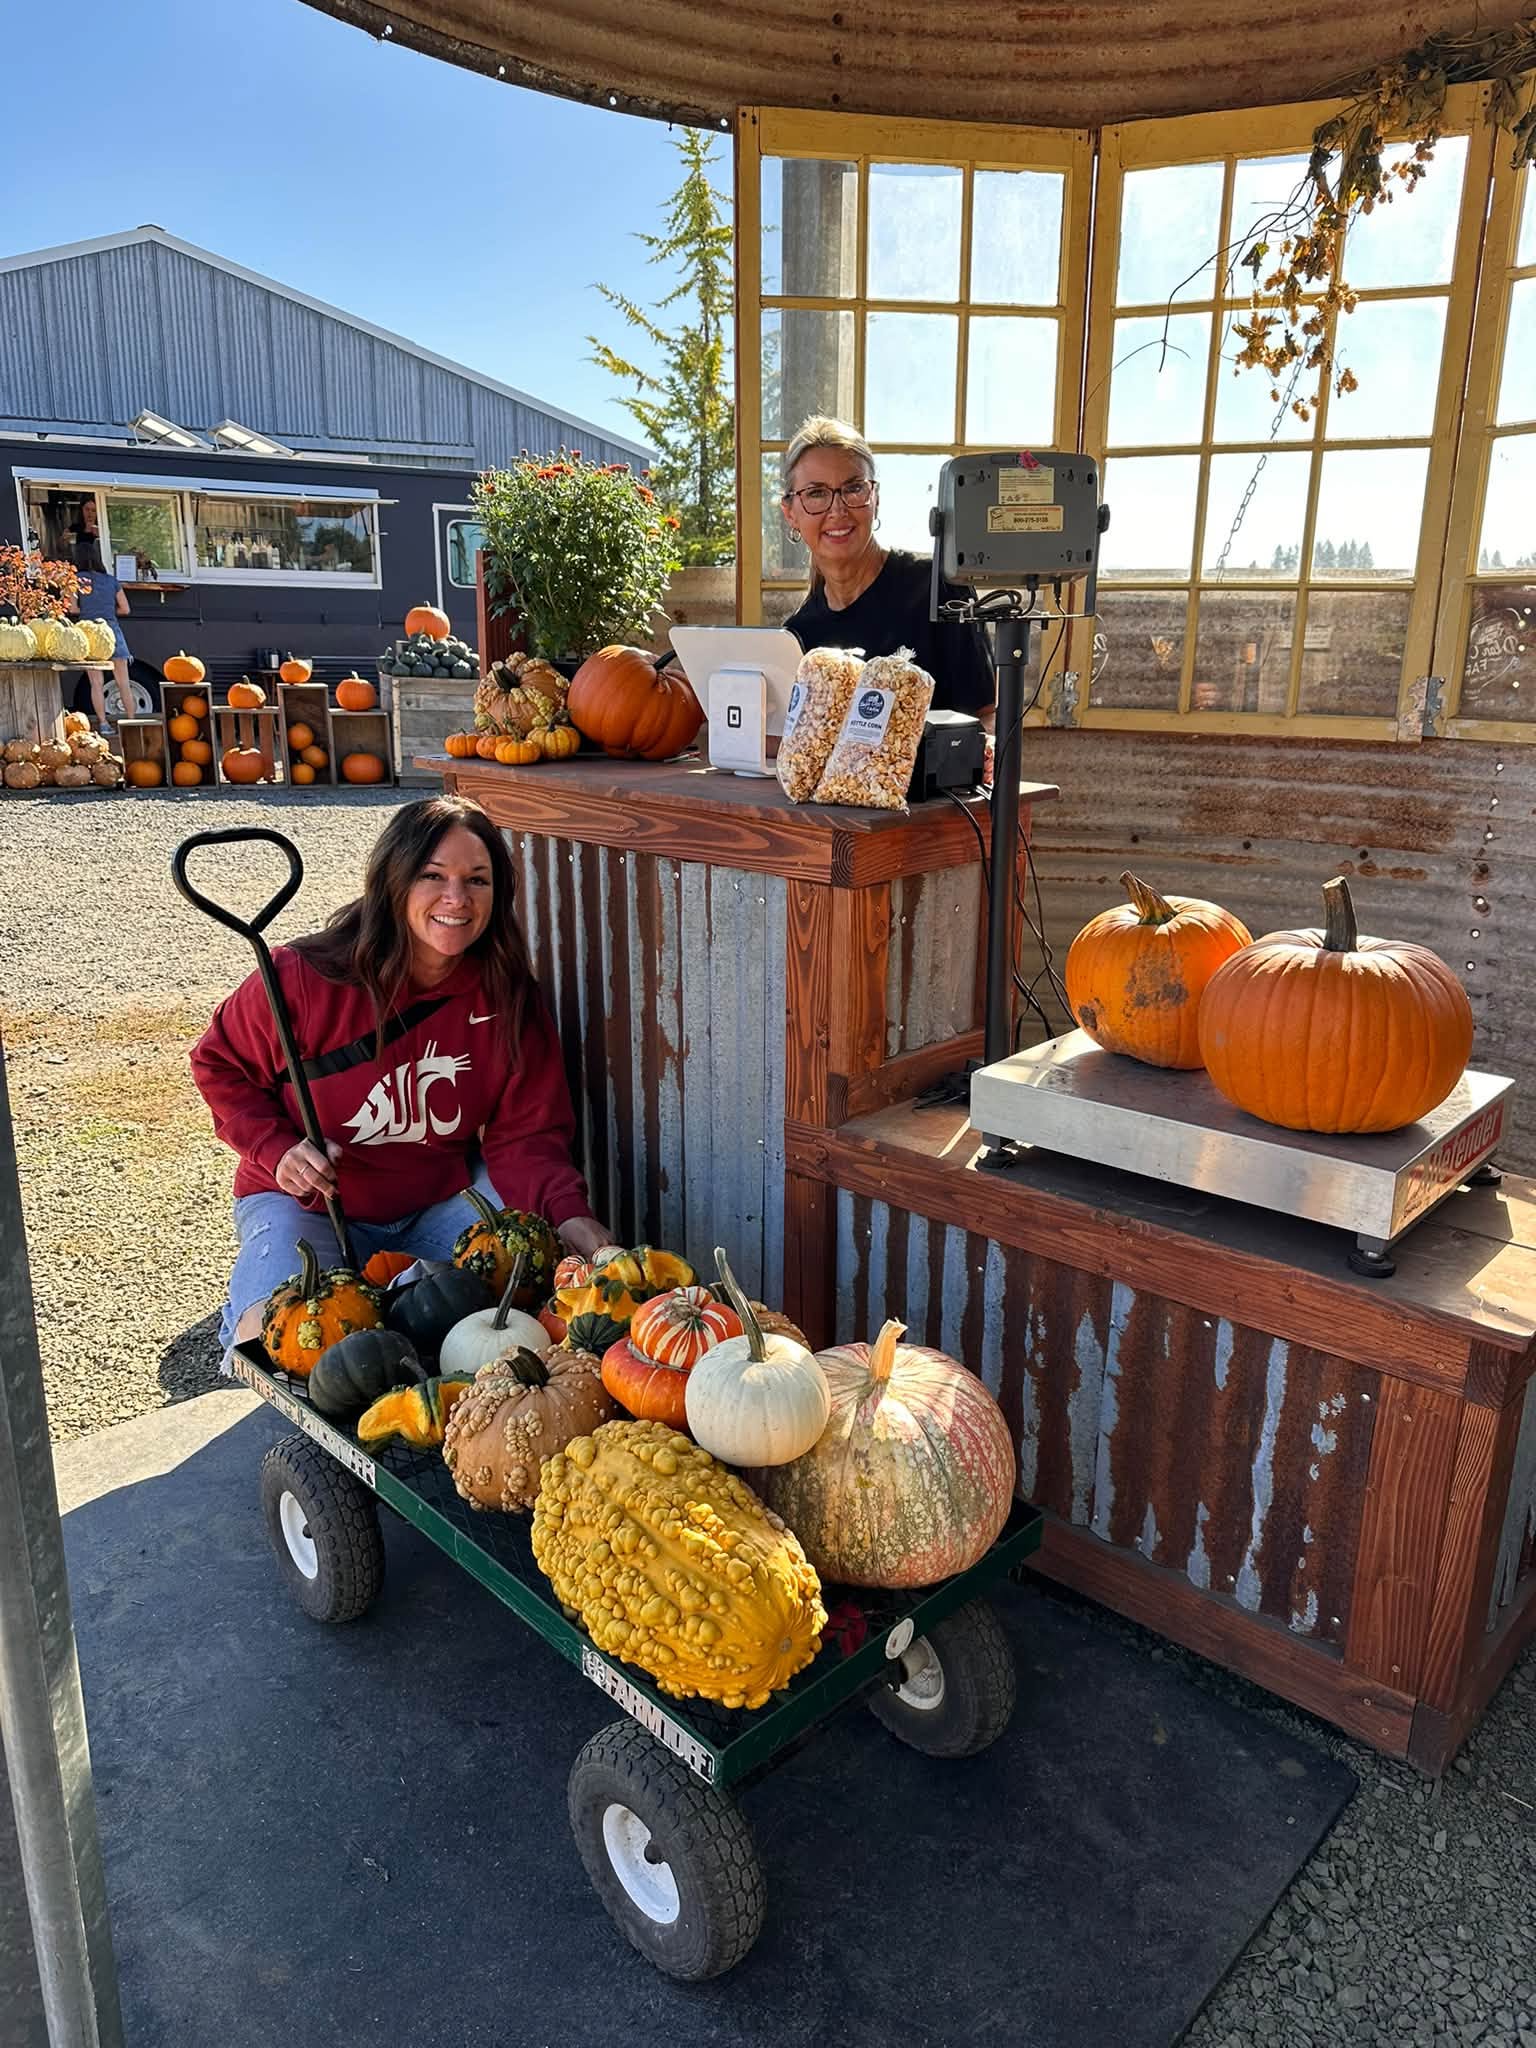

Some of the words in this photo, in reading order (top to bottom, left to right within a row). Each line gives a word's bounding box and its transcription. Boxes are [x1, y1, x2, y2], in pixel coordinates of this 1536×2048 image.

[850, 720, 868, 728] KETTLE
[868, 722, 882, 730] CORN
[605, 1664, 662, 1734] FARM
